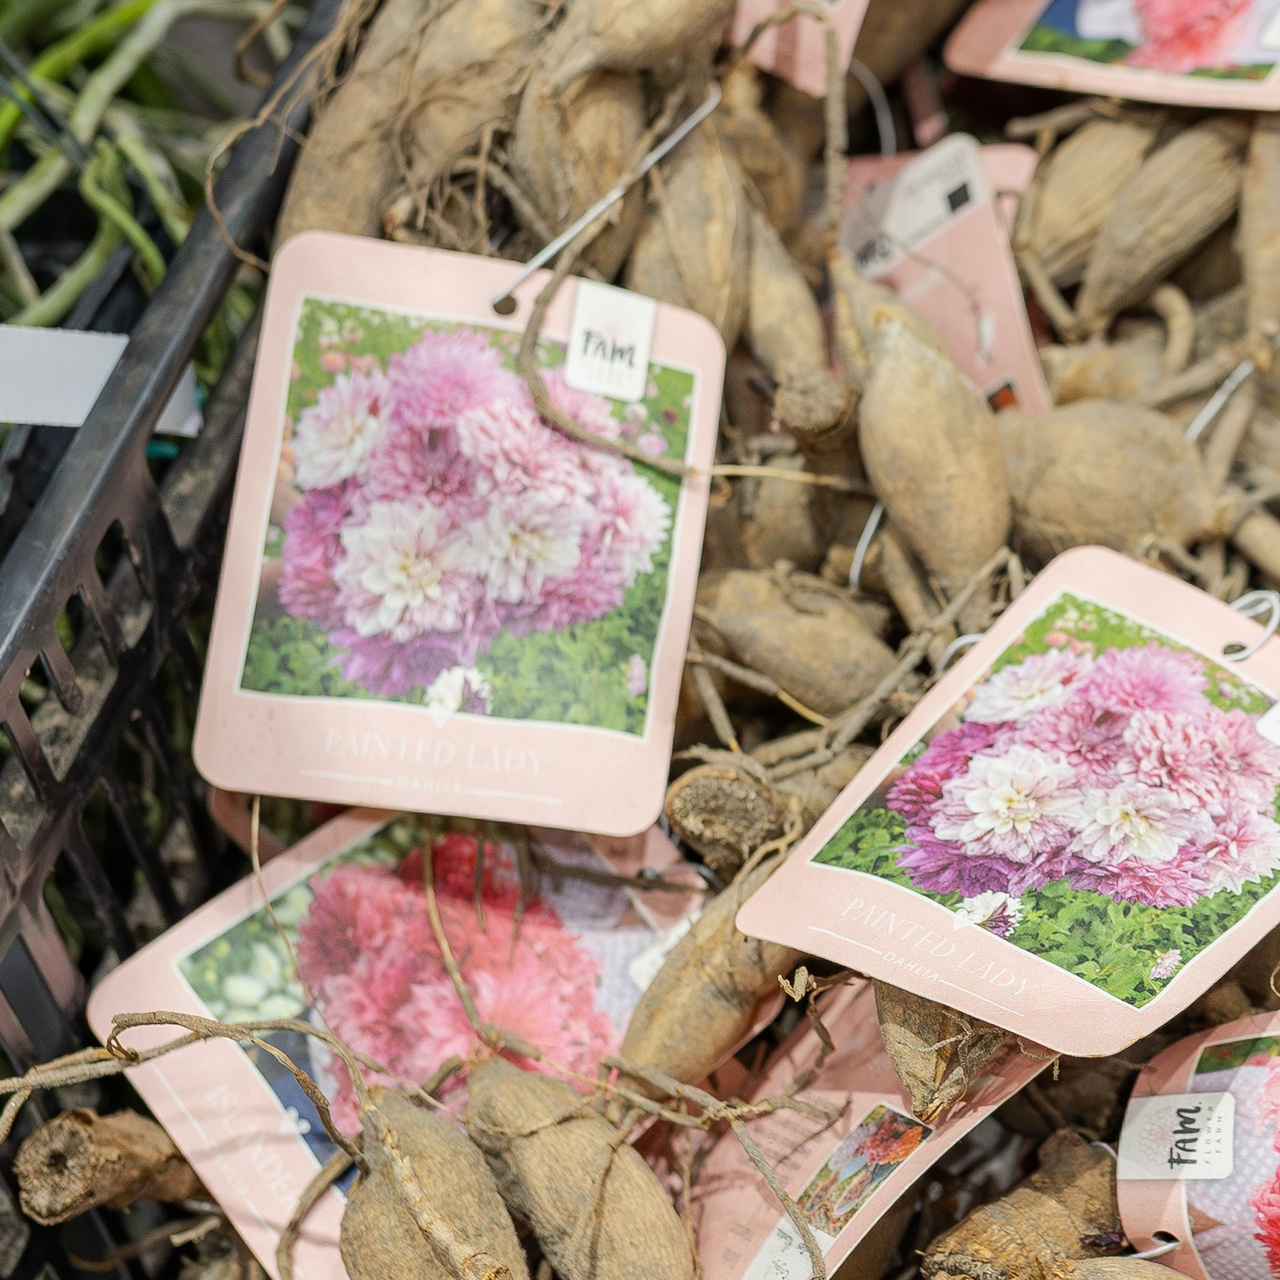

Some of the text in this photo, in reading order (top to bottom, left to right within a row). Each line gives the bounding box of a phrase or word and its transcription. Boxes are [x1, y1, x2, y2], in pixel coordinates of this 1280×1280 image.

[322, 727, 542, 776] PAINTED LADY
[840, 897, 1028, 997] PAINTED LADY
[882, 951, 940, 982] DAHLIA
